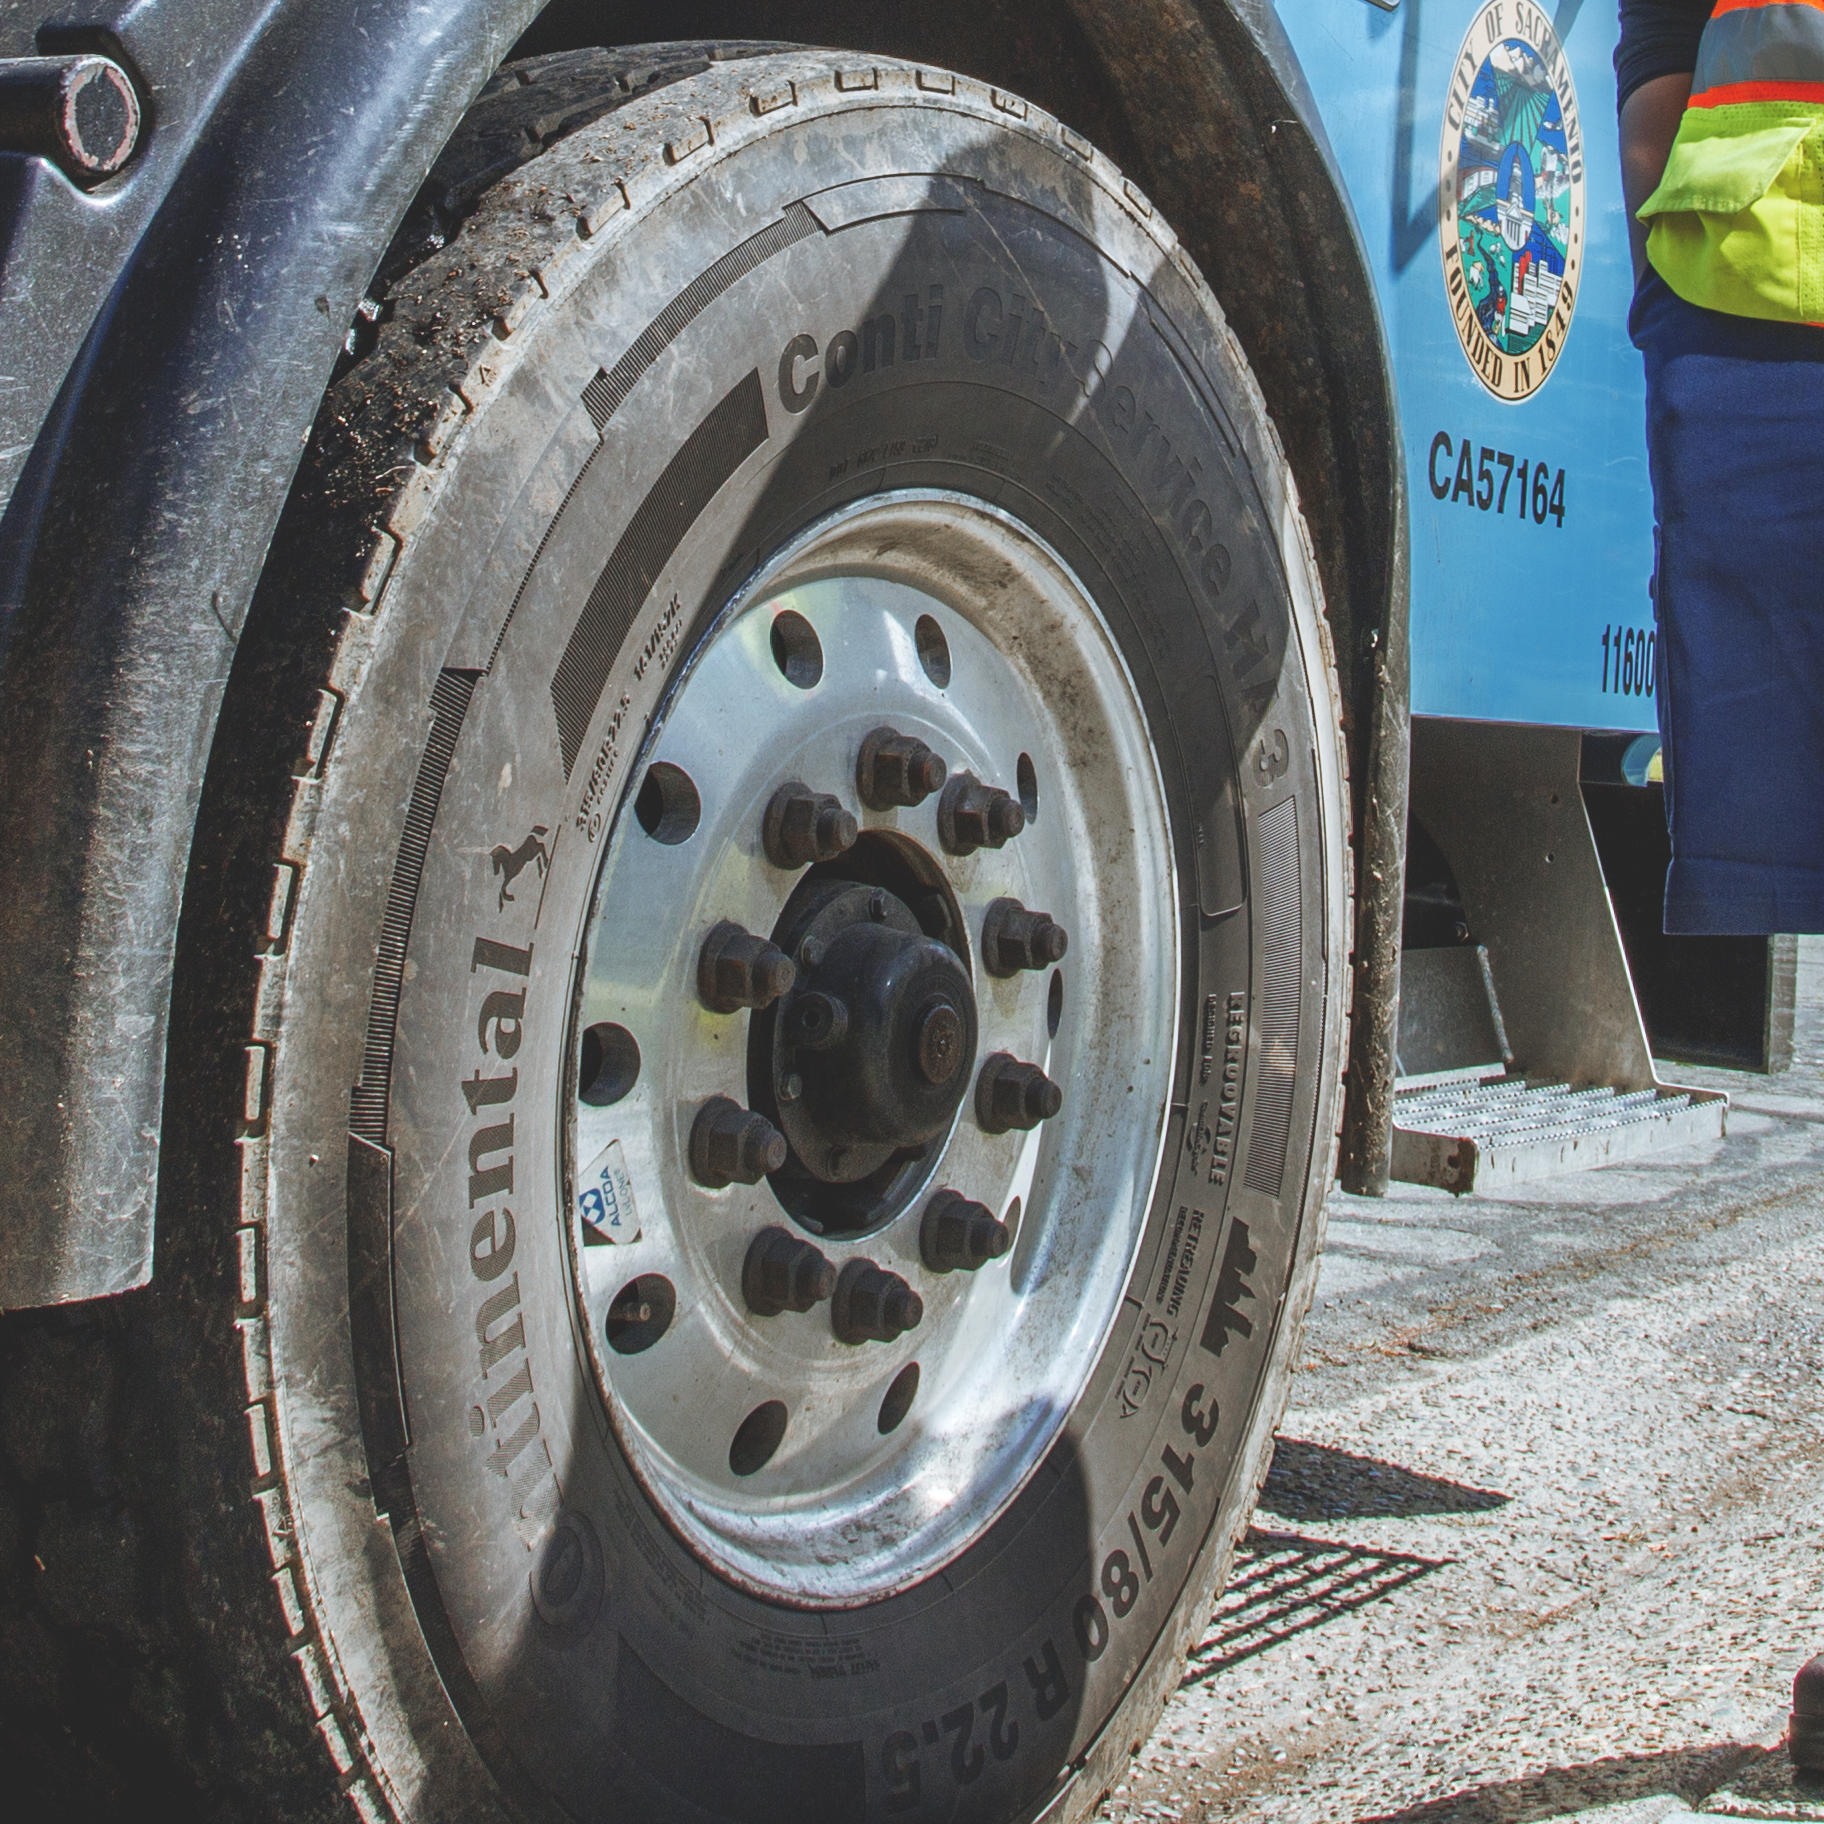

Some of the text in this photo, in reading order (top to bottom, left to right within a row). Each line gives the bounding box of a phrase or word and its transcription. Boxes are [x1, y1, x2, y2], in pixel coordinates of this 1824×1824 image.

[1447, 0, 1583, 185] CITY OF SACRAMENTO
[778, 283, 945, 415] Conti
[1445, 242, 1574, 394] FOUNDED IN 1849
[1428, 429, 1567, 530] CA57164
[1208, 990, 1246, 1187] REGROOVABLE
[600, 1164, 623, 1227] ALCOA
[1022, 1636, 1072, 1722] R
[881, 1679, 1020, 1816] 22.5
